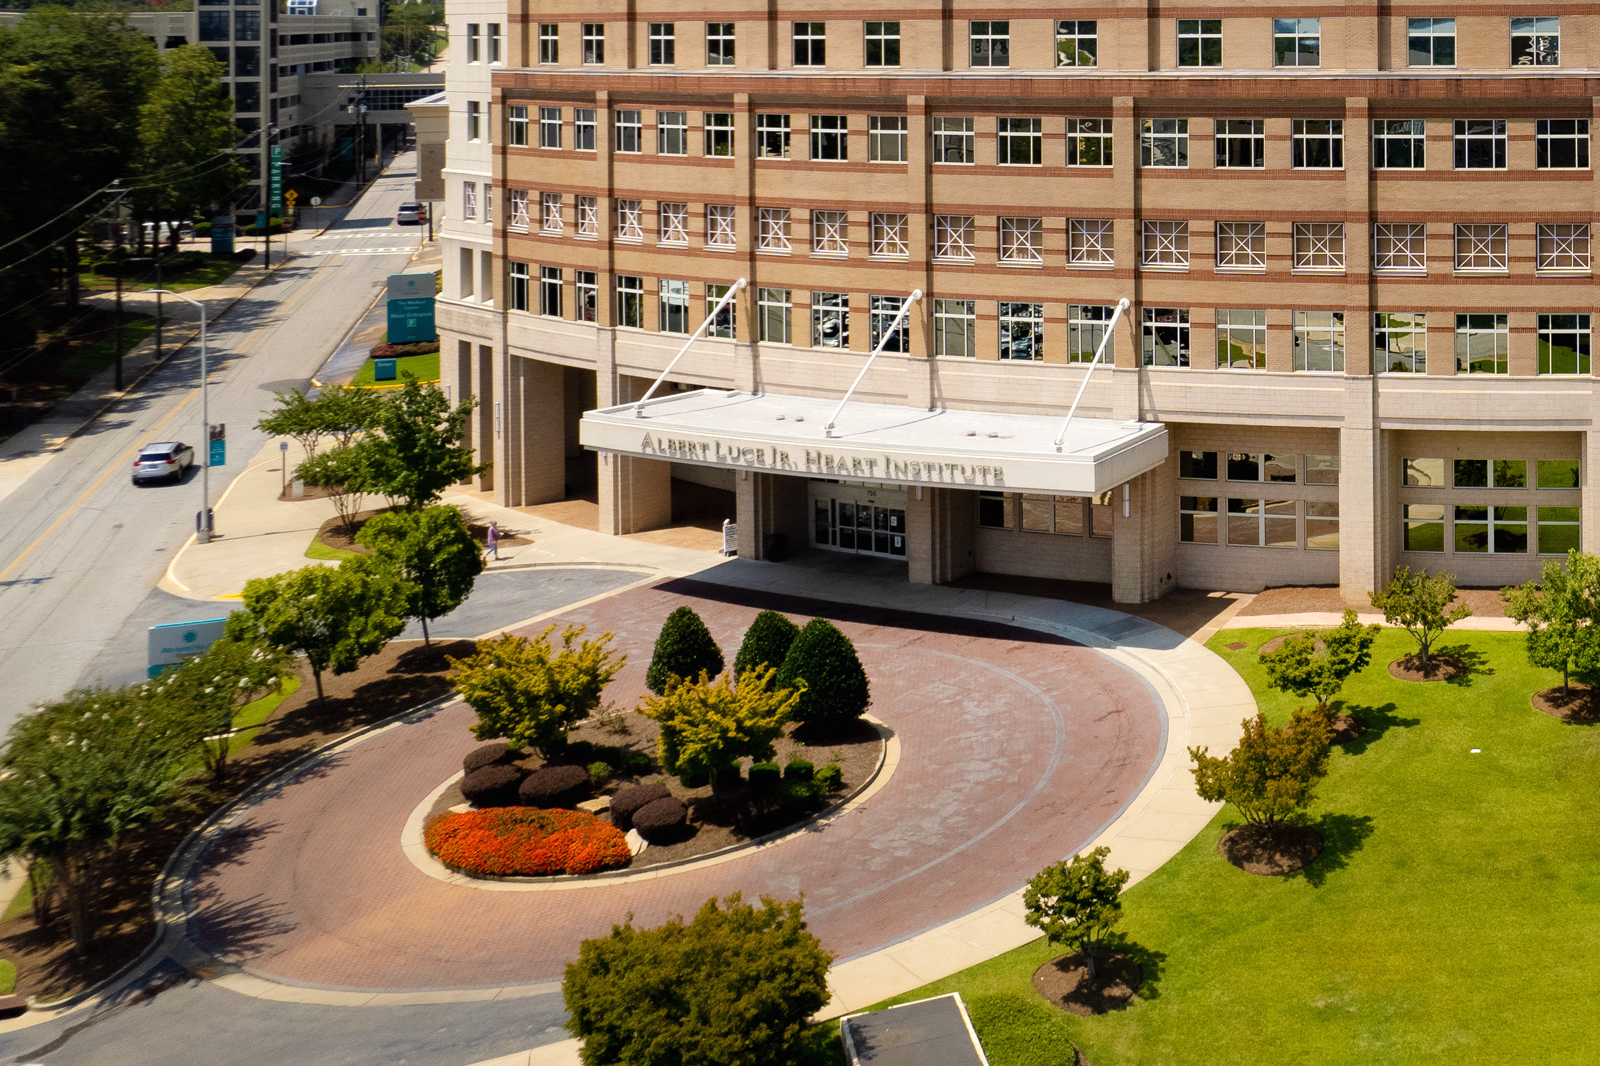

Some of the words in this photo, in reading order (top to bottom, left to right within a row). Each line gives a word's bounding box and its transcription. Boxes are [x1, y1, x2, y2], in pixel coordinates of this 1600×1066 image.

[641, 432, 709, 455] ALBERT
[714, 440, 765, 462] LUCE
[804, 448, 877, 471] HEART
[883, 454, 1005, 480] INSTITUTE
